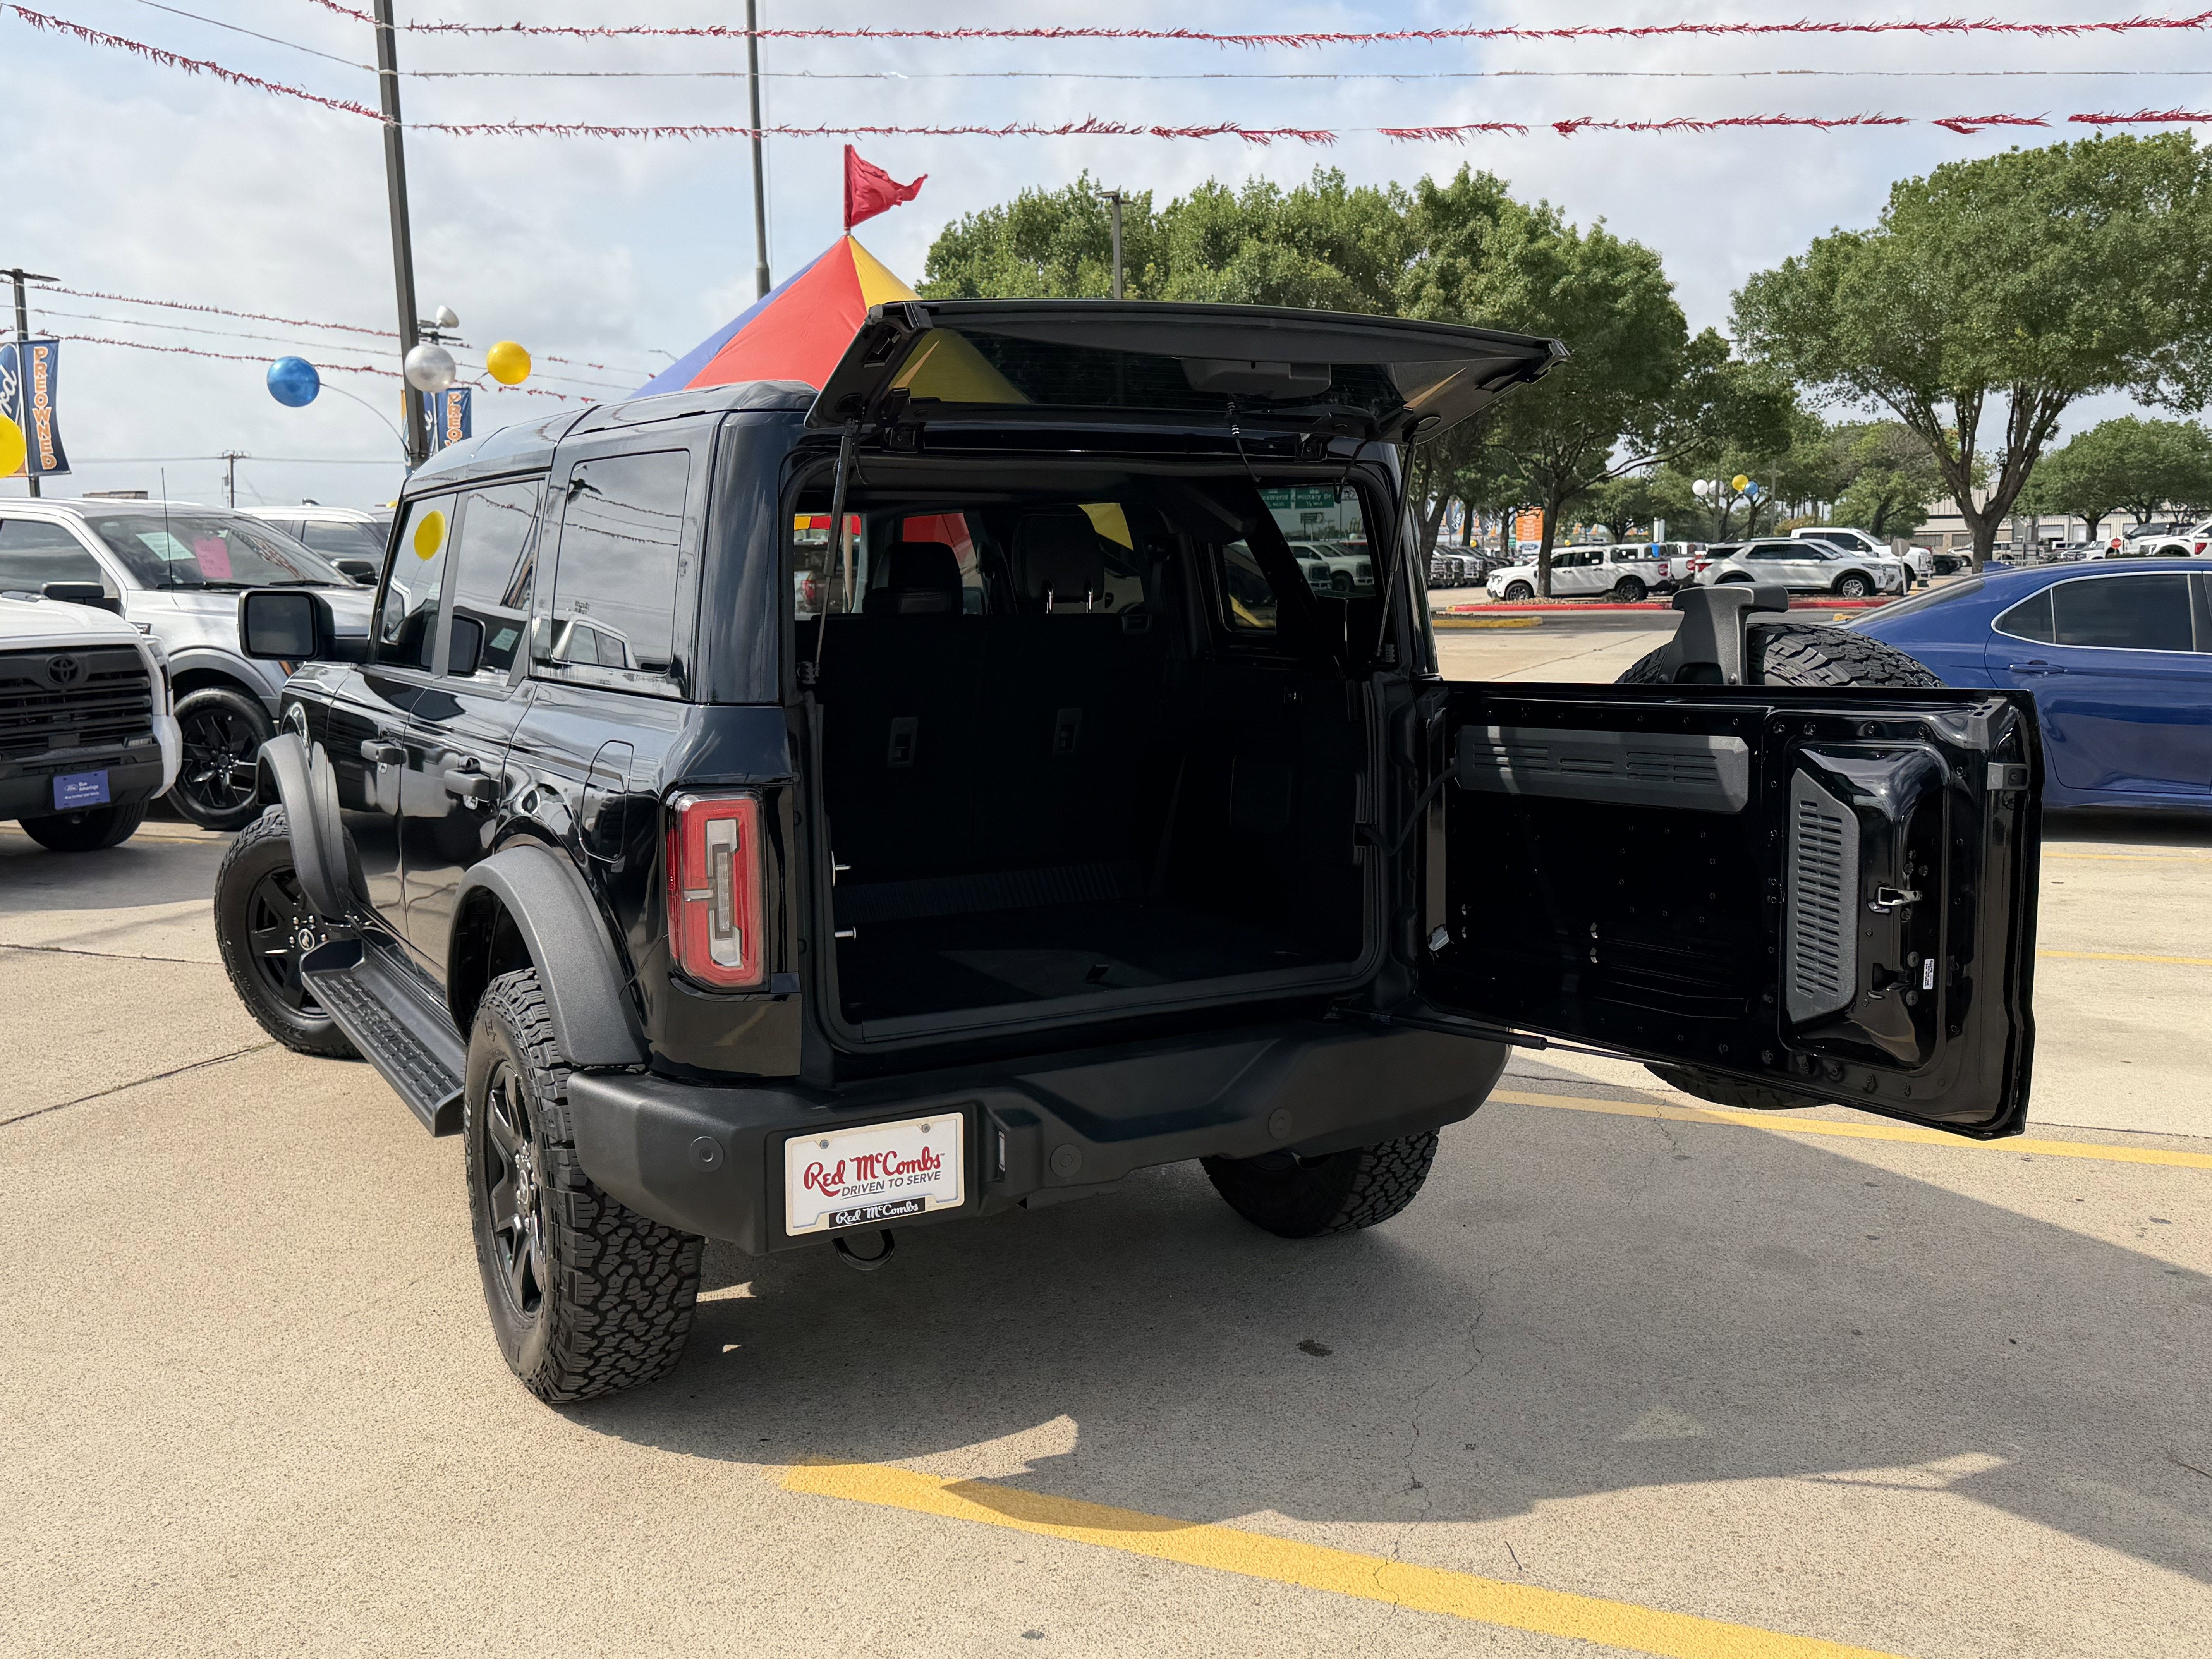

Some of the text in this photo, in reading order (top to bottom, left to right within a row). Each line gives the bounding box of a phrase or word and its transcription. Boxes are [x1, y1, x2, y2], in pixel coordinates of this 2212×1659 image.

[32, 346, 57, 470] PREOWNED
[804, 1159, 846, 1197] Red
[849, 1146, 941, 1182] McCombs
[842, 1171, 941, 1197] DRIVEN TO SERVE
[835, 1201, 919, 1225] Red McCombs
